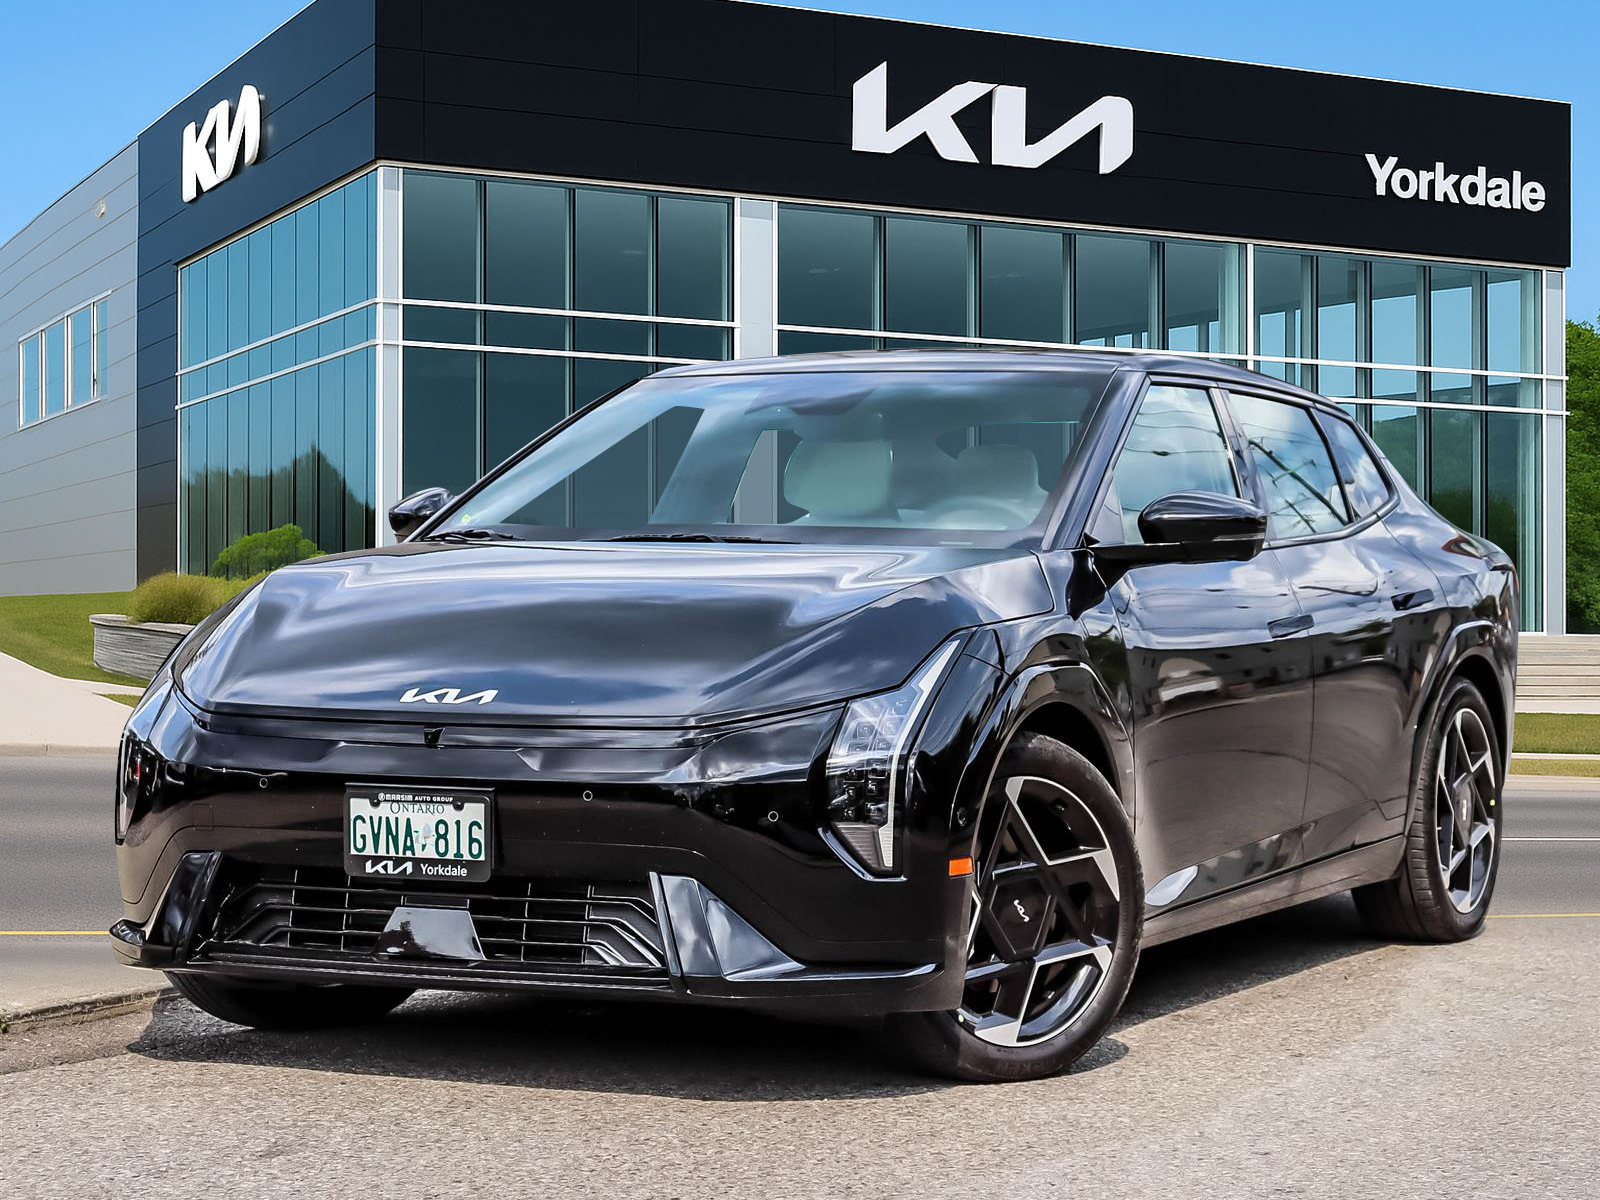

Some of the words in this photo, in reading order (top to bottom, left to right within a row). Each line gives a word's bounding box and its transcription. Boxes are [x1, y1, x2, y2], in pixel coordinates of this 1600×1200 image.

[182, 84, 261, 202] KIA
[852, 60, 1133, 174] KIA
[1365, 153, 1546, 212] Yorkdale
[399, 688, 498, 704] KIA
[352, 814, 416, 856] GVNA
[434, 819, 483, 859] 816
[365, 860, 412, 875] KIA
[420, 863, 467, 877] Yorkdale
